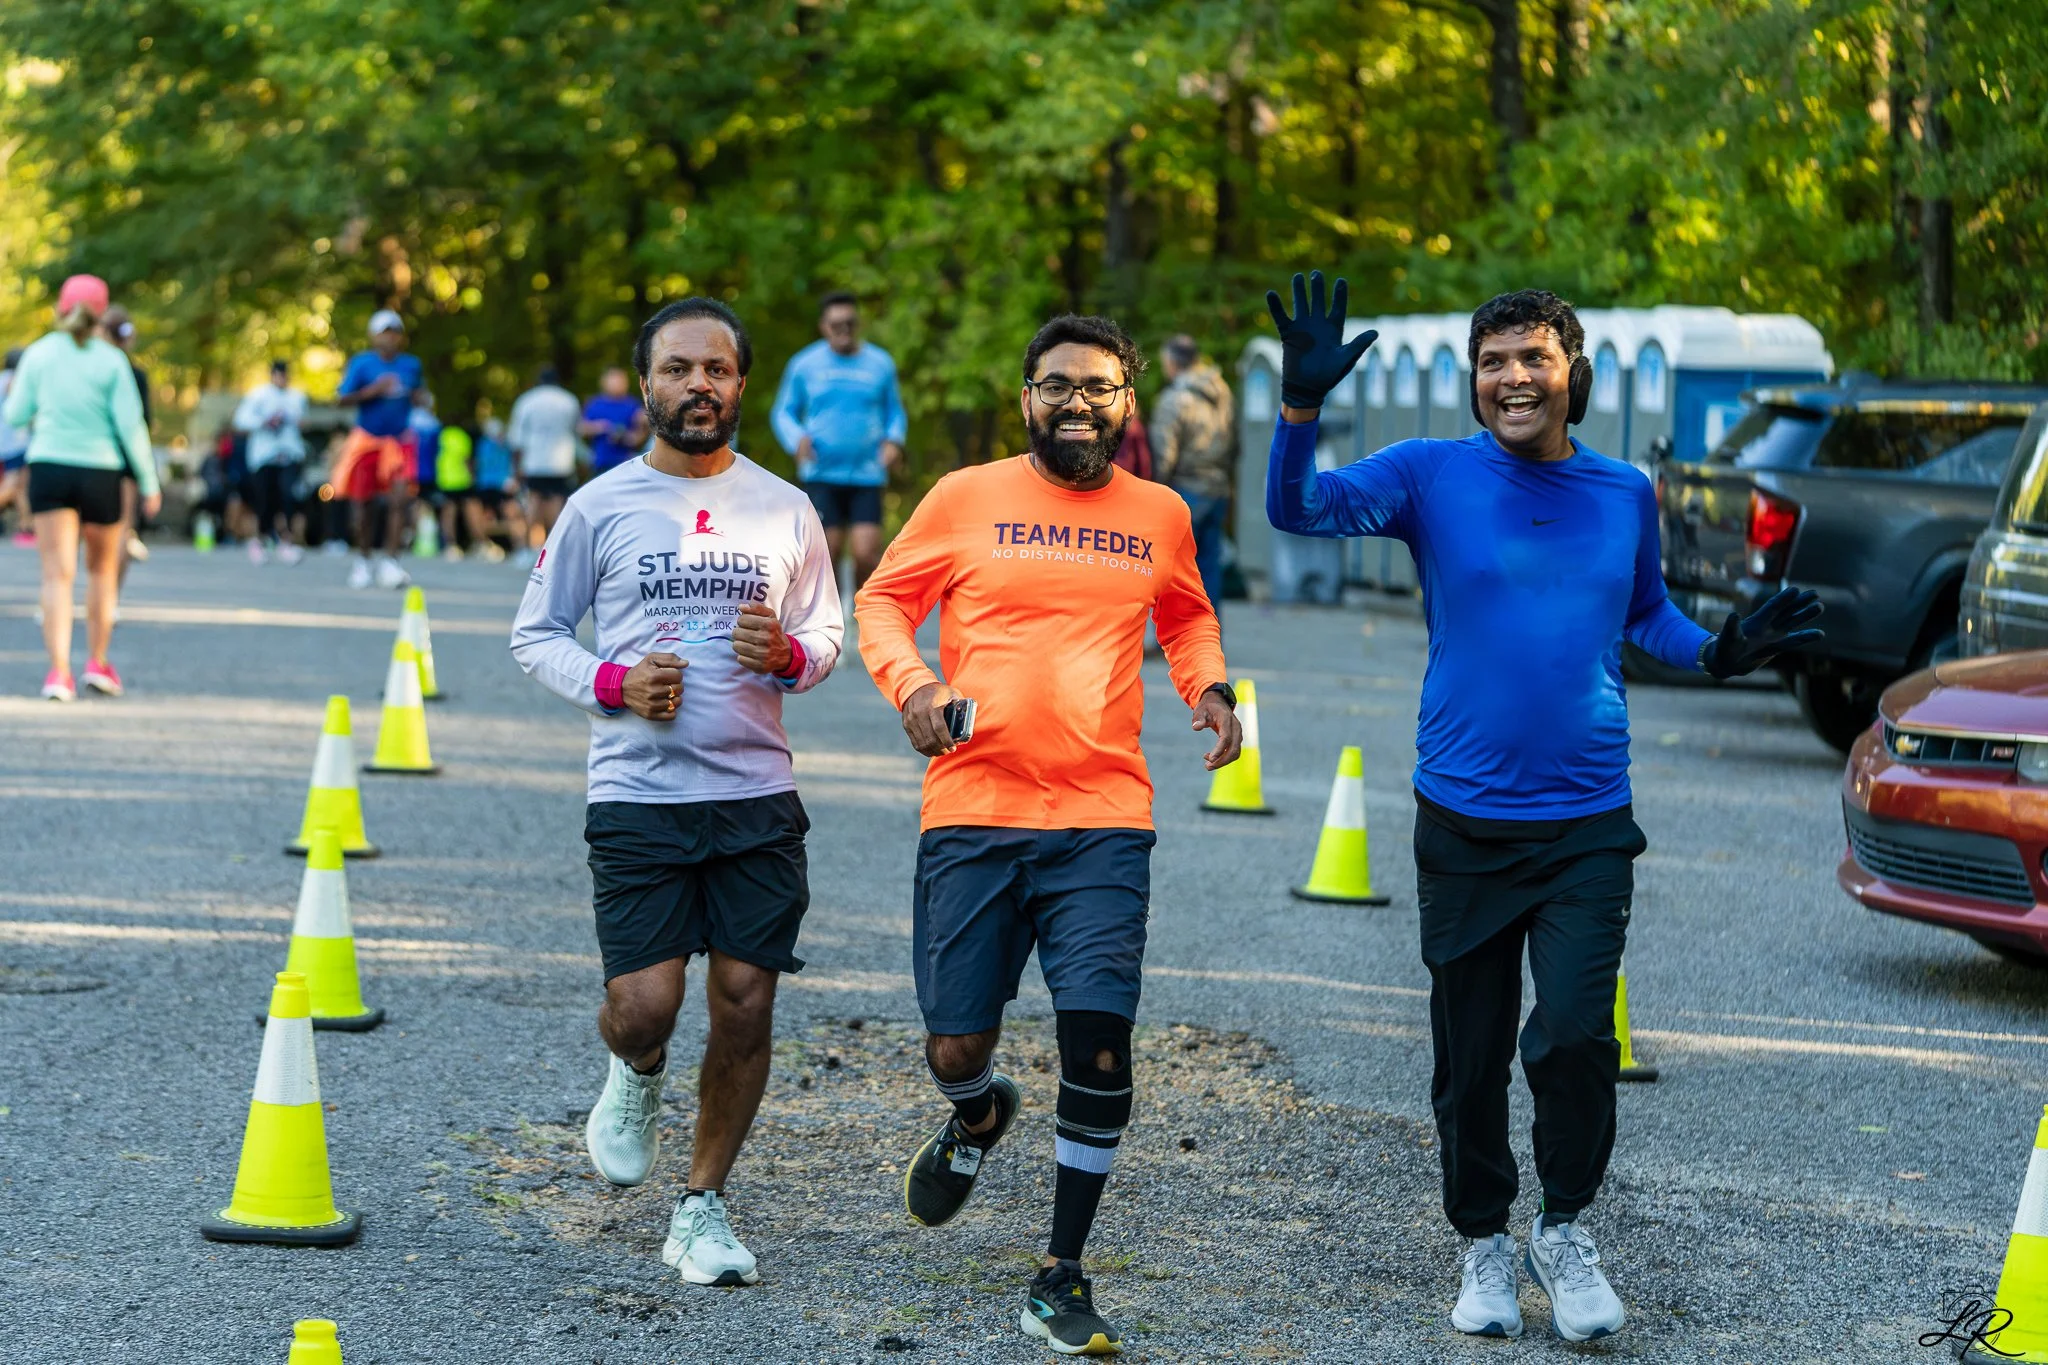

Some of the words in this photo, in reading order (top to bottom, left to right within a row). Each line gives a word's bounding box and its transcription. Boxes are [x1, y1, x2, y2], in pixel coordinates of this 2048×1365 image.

[994, 523, 1070, 548] TEAM
[1077, 527, 1153, 563] FEDEX
[638, 551, 681, 576] ST.
[689, 551, 771, 577] JUDE
[992, 548, 1014, 559] NO
[1020, 549, 1095, 565] DISTANCE
[1100, 556, 1130, 571] TOO
[1134, 563, 1153, 578] FAR
[639, 578, 770, 602] MEMPHIS
[644, 605, 709, 617] MARATHON
[711, 605, 744, 616] WEEK
[656, 621, 679, 632] 26.2
[714, 620, 732, 631] 10K
